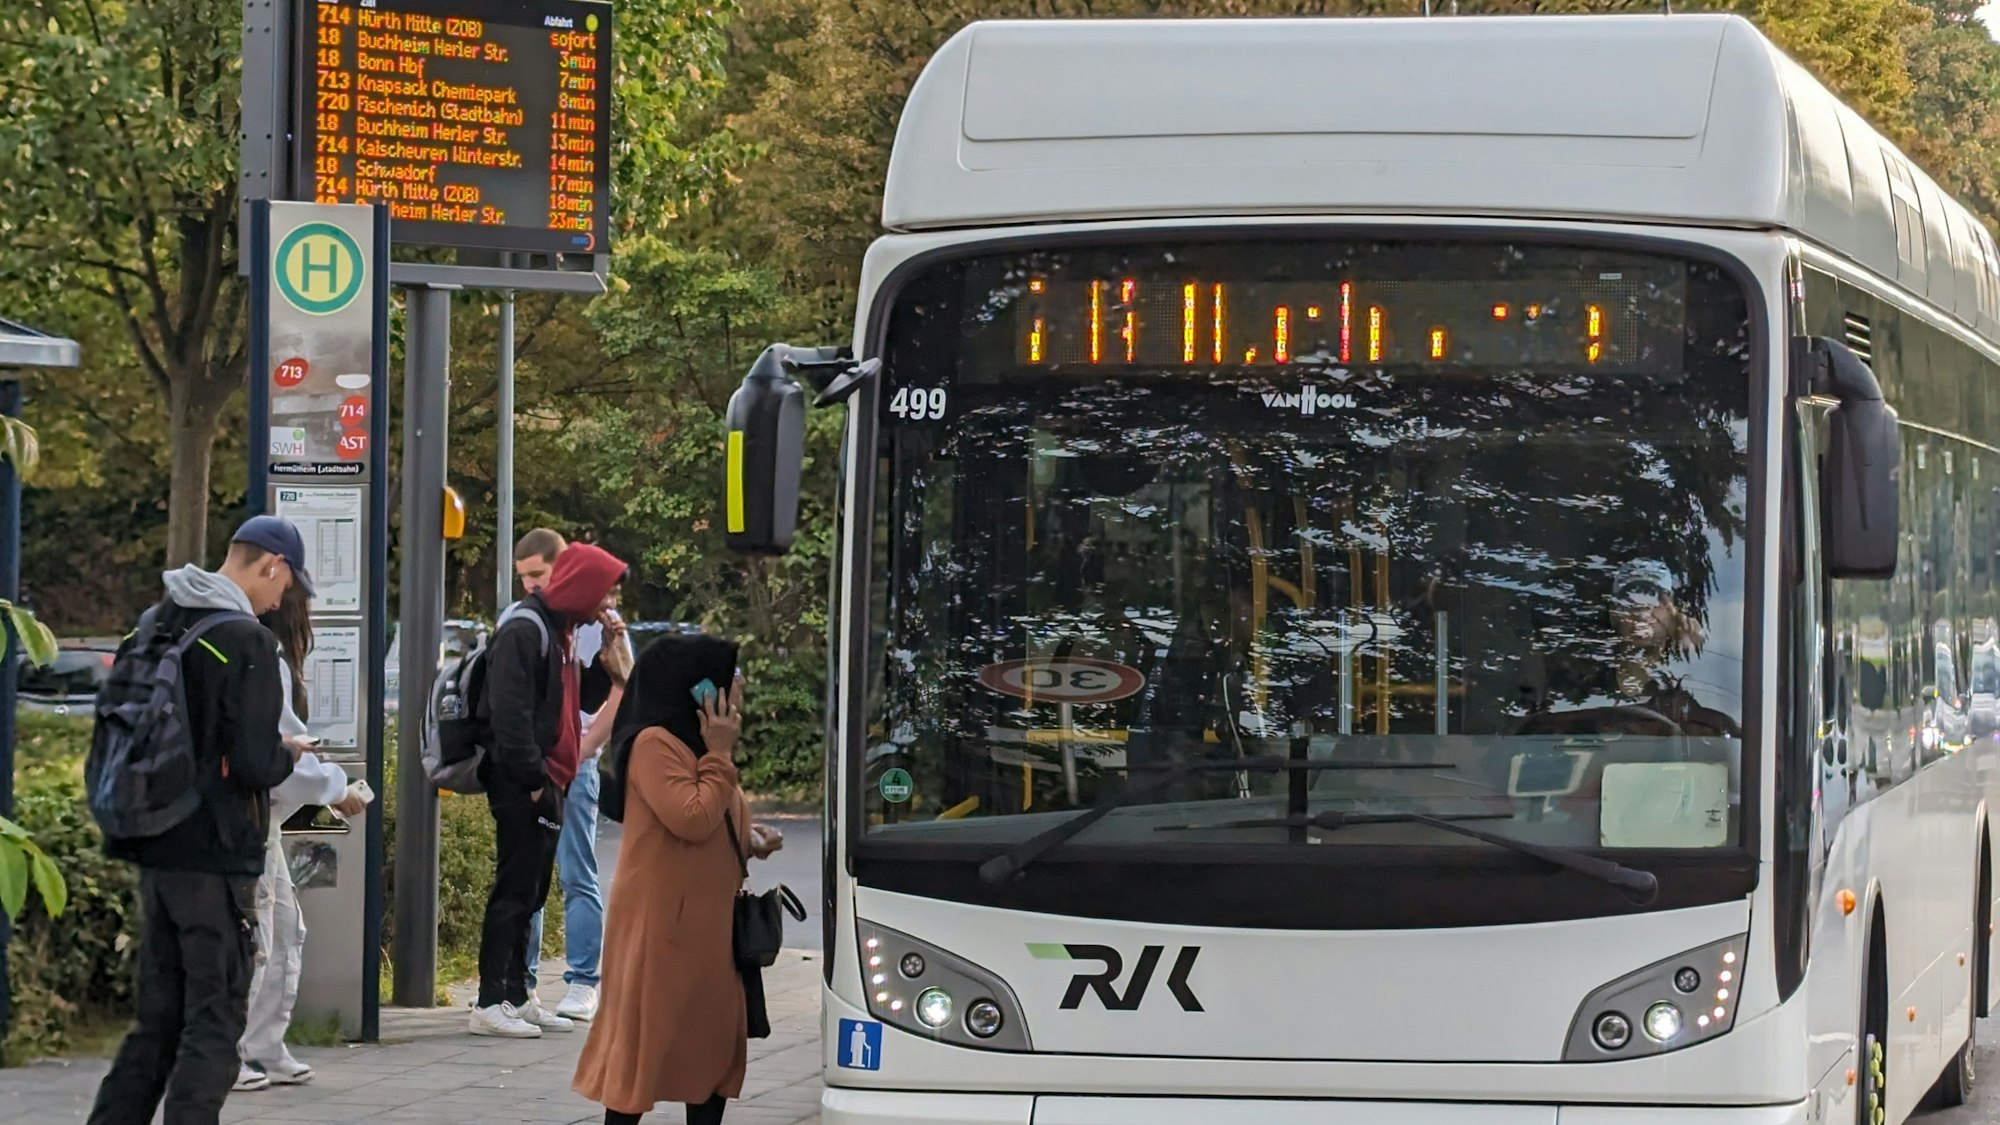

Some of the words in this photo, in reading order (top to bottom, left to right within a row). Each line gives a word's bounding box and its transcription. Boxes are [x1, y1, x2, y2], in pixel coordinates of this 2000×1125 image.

[318, 6, 350, 26] 714
[358, 9, 401, 31] Hürth
[406, 14, 441, 34] Mitte
[446, 18, 482, 39] (ZOB)
[544, 15, 573, 29] Abfahrt
[318, 28, 339, 45] 18
[551, 29, 595, 51] sofort
[359, 31, 429, 54] Buchheim
[435, 40, 480, 59] Herler
[484, 43, 508, 62] Str.
[318, 49, 339, 67] 18
[359, 52, 396, 72] Bonn
[400, 57, 425, 79] Hbf
[560, 51, 595, 69] 3min
[318, 71, 350, 89] 713
[560, 72, 595, 89] 7min
[358, 74, 428, 97] Knapsack
[433, 81, 516, 106] Chemiepark
[318, 92, 350, 111] 720
[560, 92, 595, 110] 8min
[358, 96, 435, 118] Fischenich
[441, 103, 523, 126] (Stadtbahn)
[317, 114, 337, 131] 18
[551, 114, 595, 131] 11min
[358, 118, 428, 139] Buchheim
[433, 123, 479, 142] Herler
[483, 127, 507, 146] Str.
[317, 136, 348, 153] 714
[551, 133, 595, 152] 13min
[357, 139, 448, 162] Kalscheuren
[453, 145, 522, 168] Winterstr.
[317, 158, 337, 174] 18
[357, 160, 437, 183] Schwadorf
[551, 154, 594, 173] 14min
[317, 177, 348, 195] 714
[356, 179, 399, 199] Hürth
[404, 183, 438, 201] Mitte
[444, 186, 479, 203] (ZOB)
[550, 176, 593, 193] 17min
[550, 194, 593, 212] 18min
[432, 203, 477, 223] Herler
[482, 207, 505, 224] Str.
[549, 214, 593, 231] 23min
[302, 243, 337, 293] H
[282, 365, 302, 379] 713
[340, 405, 364, 416] 714
[890, 389, 946, 420] 499
[272, 442, 303, 454] SWH
[340, 436, 366, 449] AST
[282, 492, 296, 500] 720
[892, 770, 900, 785] 4
